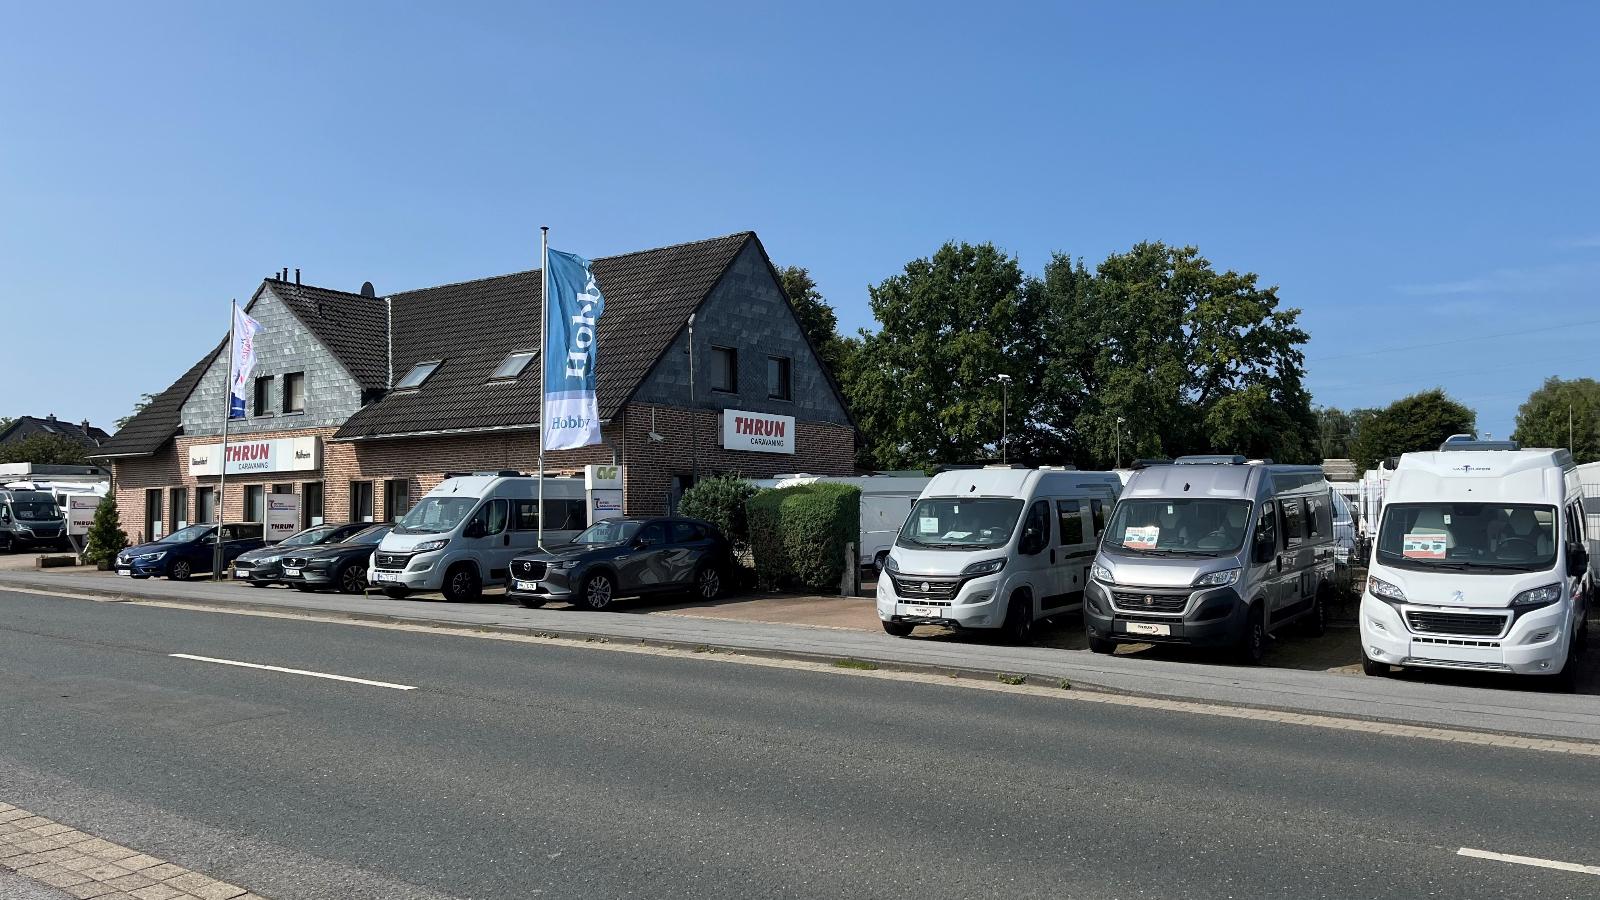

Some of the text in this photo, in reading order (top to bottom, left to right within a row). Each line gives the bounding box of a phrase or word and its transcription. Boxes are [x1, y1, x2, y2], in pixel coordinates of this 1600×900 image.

[551, 415, 590, 431] Hobby
[735, 416, 785, 437] THRUN
[225, 443, 270, 462] THRUN
[238, 461, 269, 470] CARAVANING
